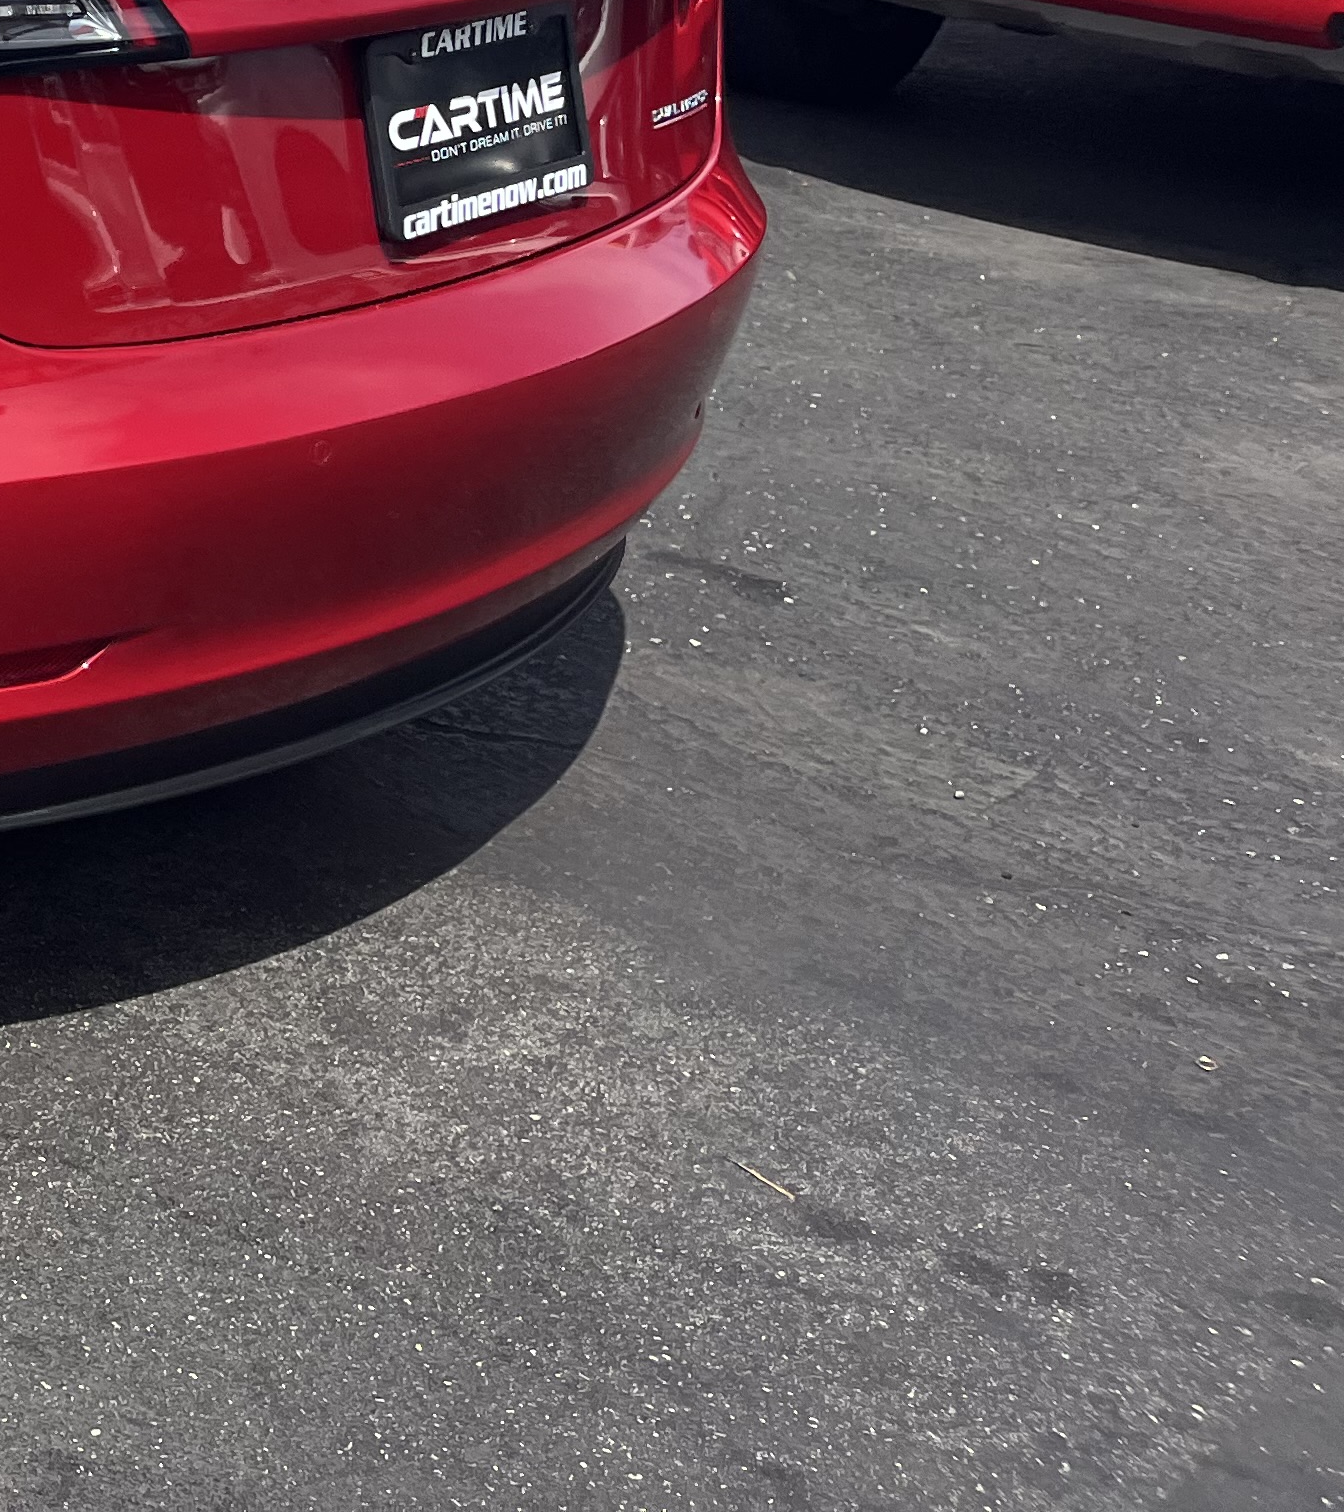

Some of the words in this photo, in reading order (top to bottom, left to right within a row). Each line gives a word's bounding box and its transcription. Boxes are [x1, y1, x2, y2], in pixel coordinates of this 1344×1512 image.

[421, 10, 527, 58] CARTIME
[388, 70, 565, 152] CARTIME
[431, 141, 467, 163] DON'T
[469, 132, 510, 153] DREAM
[523, 120, 554, 137] DRIVE
[403, 163, 587, 240] cartimenow.com
